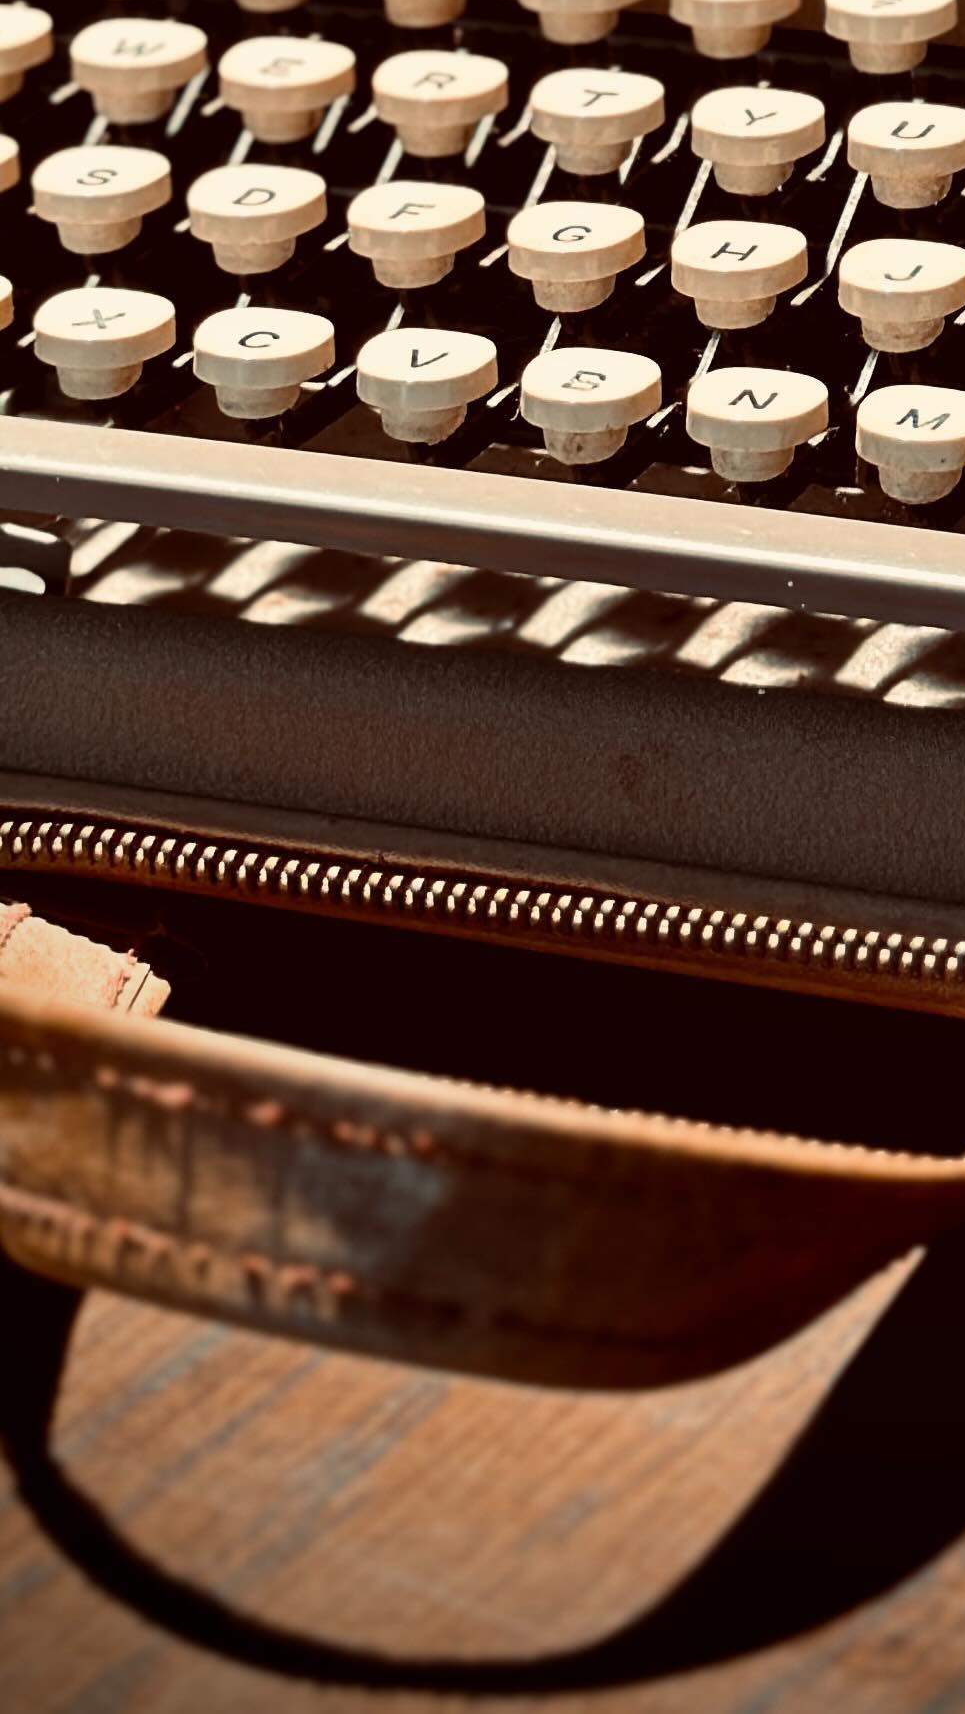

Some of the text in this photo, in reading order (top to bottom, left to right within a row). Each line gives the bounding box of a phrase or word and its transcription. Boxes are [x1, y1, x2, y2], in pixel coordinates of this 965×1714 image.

[113, 39, 165, 58] W
[258, 57, 305, 77] E
[413, 71, 457, 90] R
[583, 89, 620, 108] T
[744, 108, 777, 127] Y
[890, 120, 936, 140] U
[76, 169, 118, 186] S
[232, 187, 277, 206] D
[388, 202, 436, 220] F
[552, 225, 592, 242] G
[710, 241, 758, 262] H
[884, 264, 923, 282] J
[71, 308, 127, 330] X
[237, 331, 280, 349] C
[410, 348, 449, 369] V
[729, 389, 779, 410] N
[895, 408, 951, 431] M
